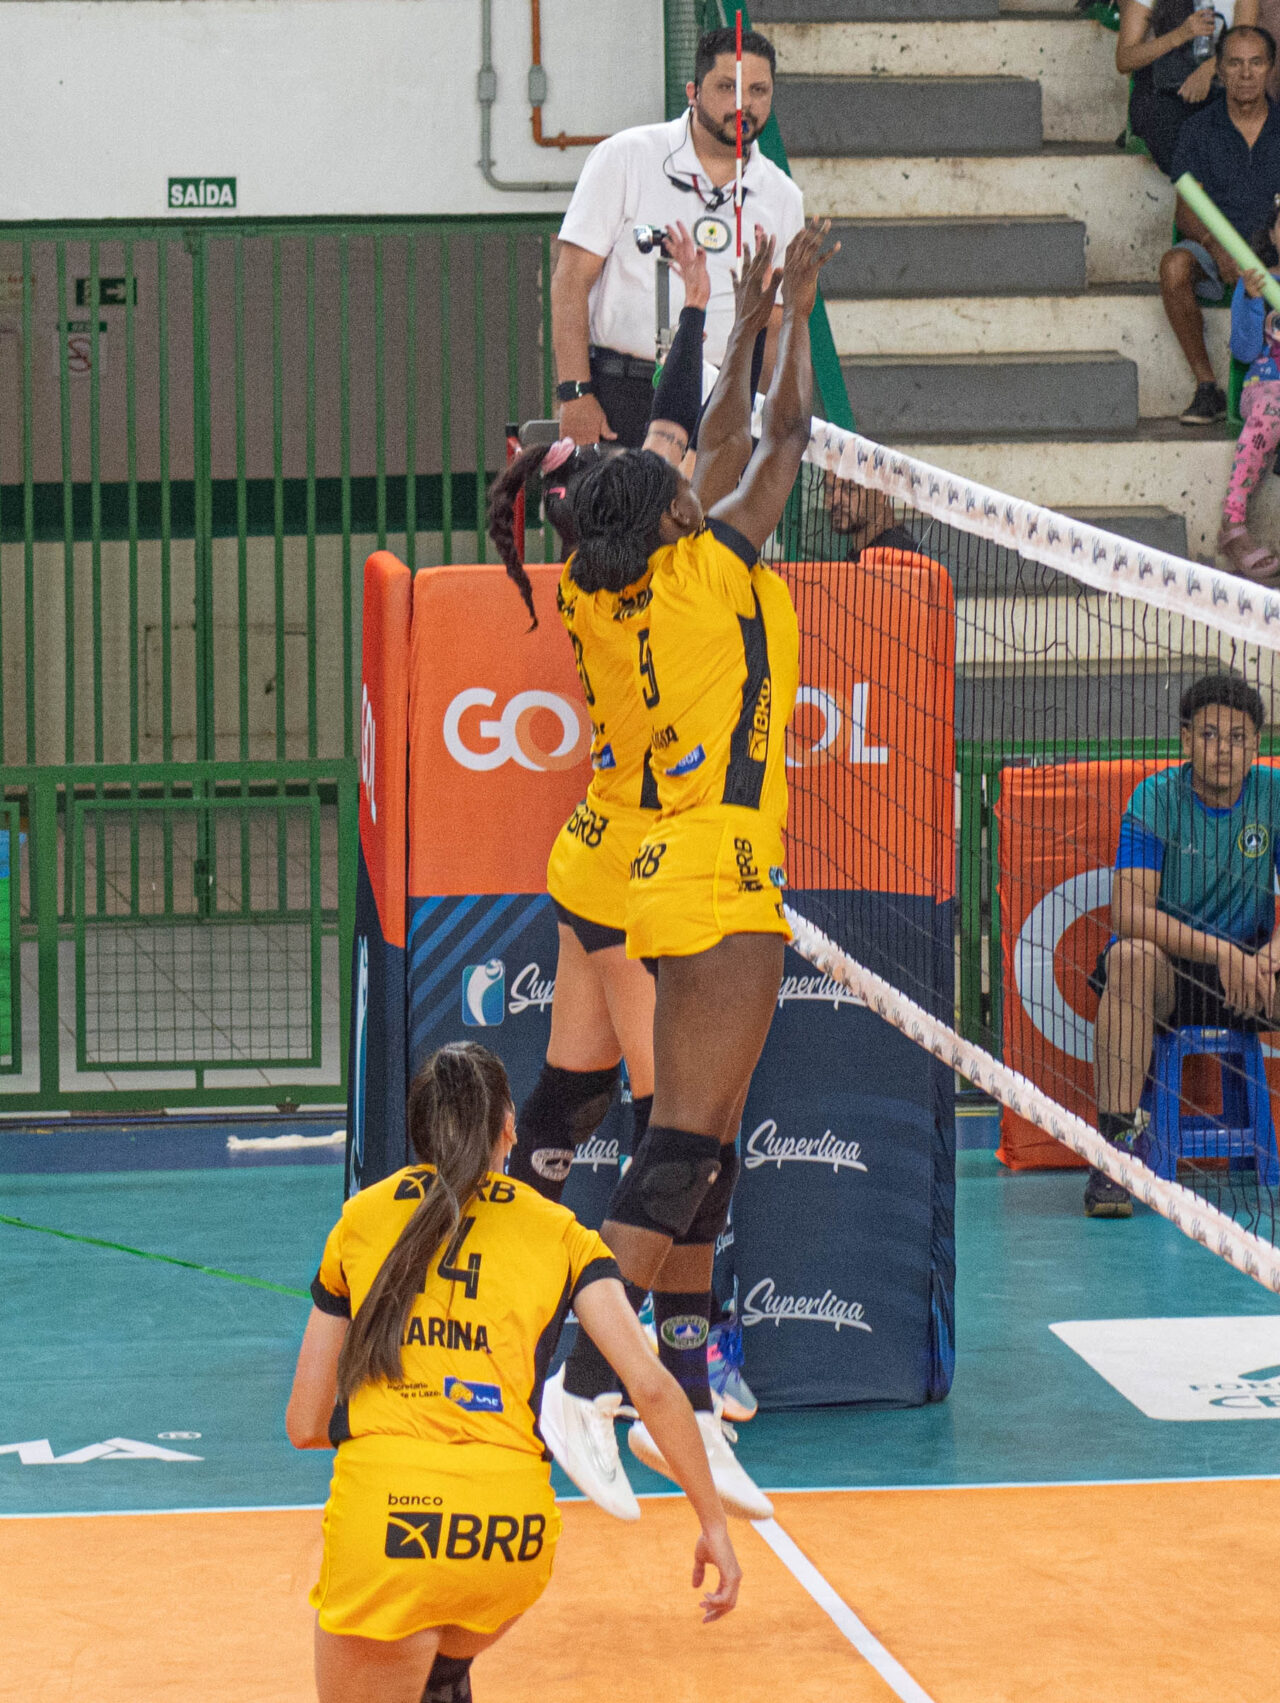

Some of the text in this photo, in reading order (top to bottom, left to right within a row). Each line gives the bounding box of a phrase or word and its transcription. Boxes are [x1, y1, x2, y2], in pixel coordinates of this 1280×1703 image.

[171, 179, 234, 206] SAÍDA
[629, 842, 668, 880] RB
[745, 1118, 868, 1174] Superliga
[741, 1277, 873, 1334] Superliga
[400, 1316, 492, 1354] ARINA
[387, 1493, 443, 1506] banco
[445, 1512, 546, 1562] BRB
